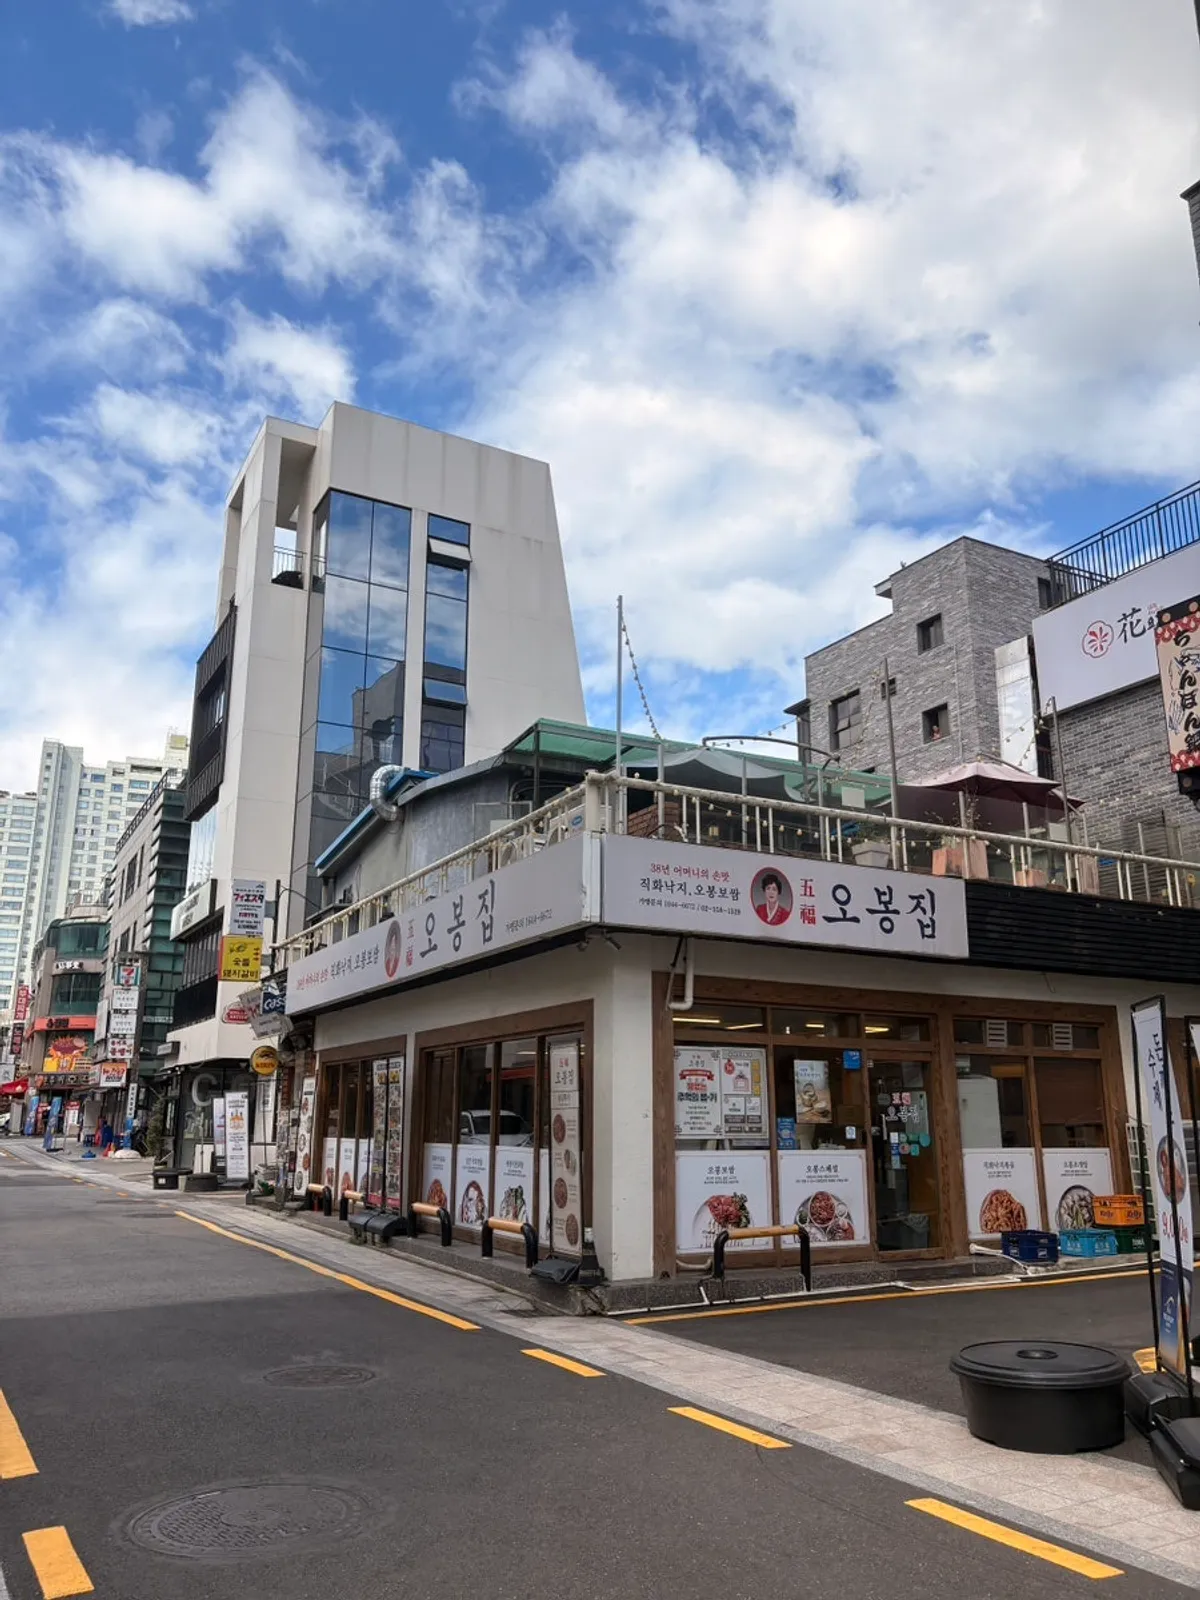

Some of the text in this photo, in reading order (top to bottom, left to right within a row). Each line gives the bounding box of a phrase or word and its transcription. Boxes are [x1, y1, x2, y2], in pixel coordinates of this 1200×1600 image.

[650, 863, 670, 876] 38년
[673, 865, 709, 880] 어머니의
[420, 878, 495, 958] 오봉집
[822, 883, 937, 940] 오봉집
